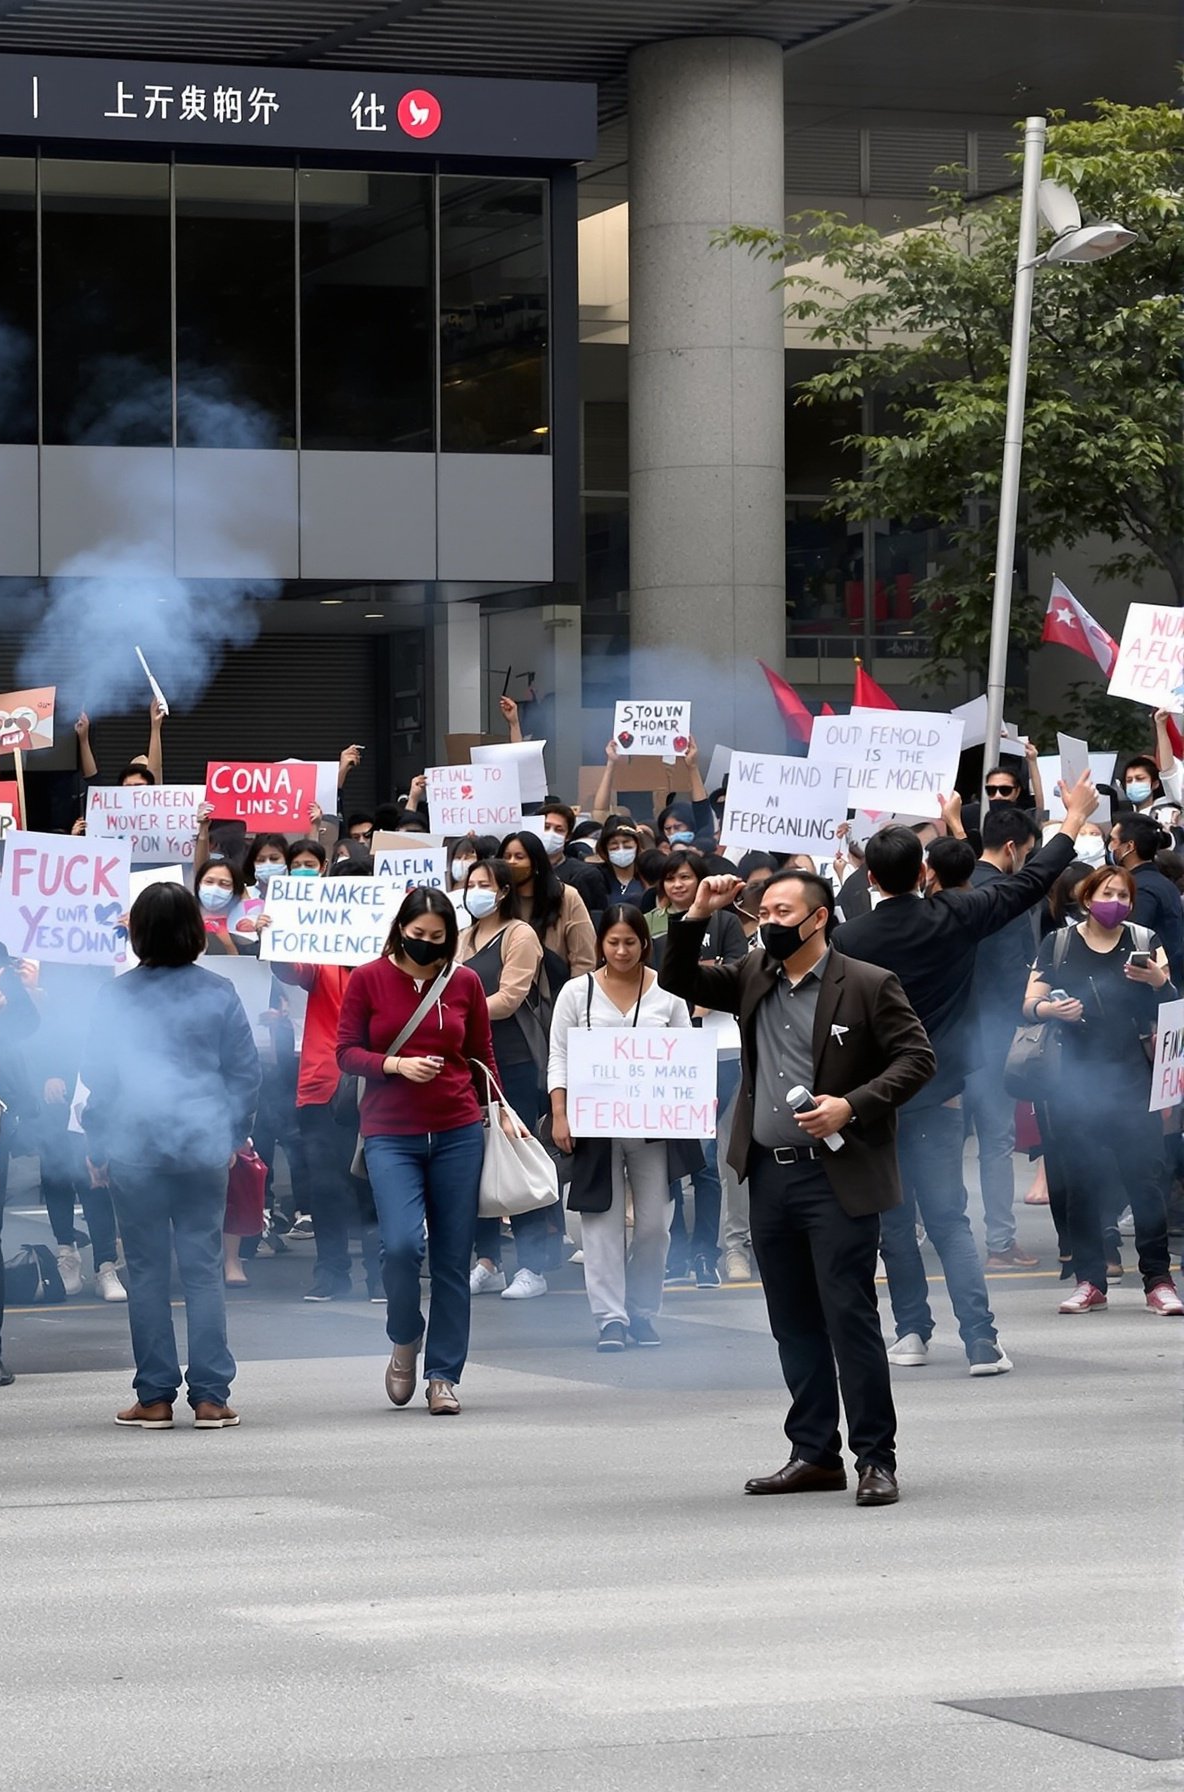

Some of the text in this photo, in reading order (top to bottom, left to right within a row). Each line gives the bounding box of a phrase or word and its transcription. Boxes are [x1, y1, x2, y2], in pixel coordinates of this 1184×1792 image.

[866, 749, 924, 763] IS THE
[211, 765, 292, 794] CONA
[483, 768, 502, 781] TO
[738, 760, 765, 784] WE
[91, 792, 123, 810] ALL
[12, 848, 120, 898] FUCK
[319, 883, 385, 906] NAKEE
[297, 907, 352, 925] WINK
[614, 1036, 678, 1061] KLLY
[652, 1085, 665, 1098] IN
[673, 1086, 695, 1100] THE
